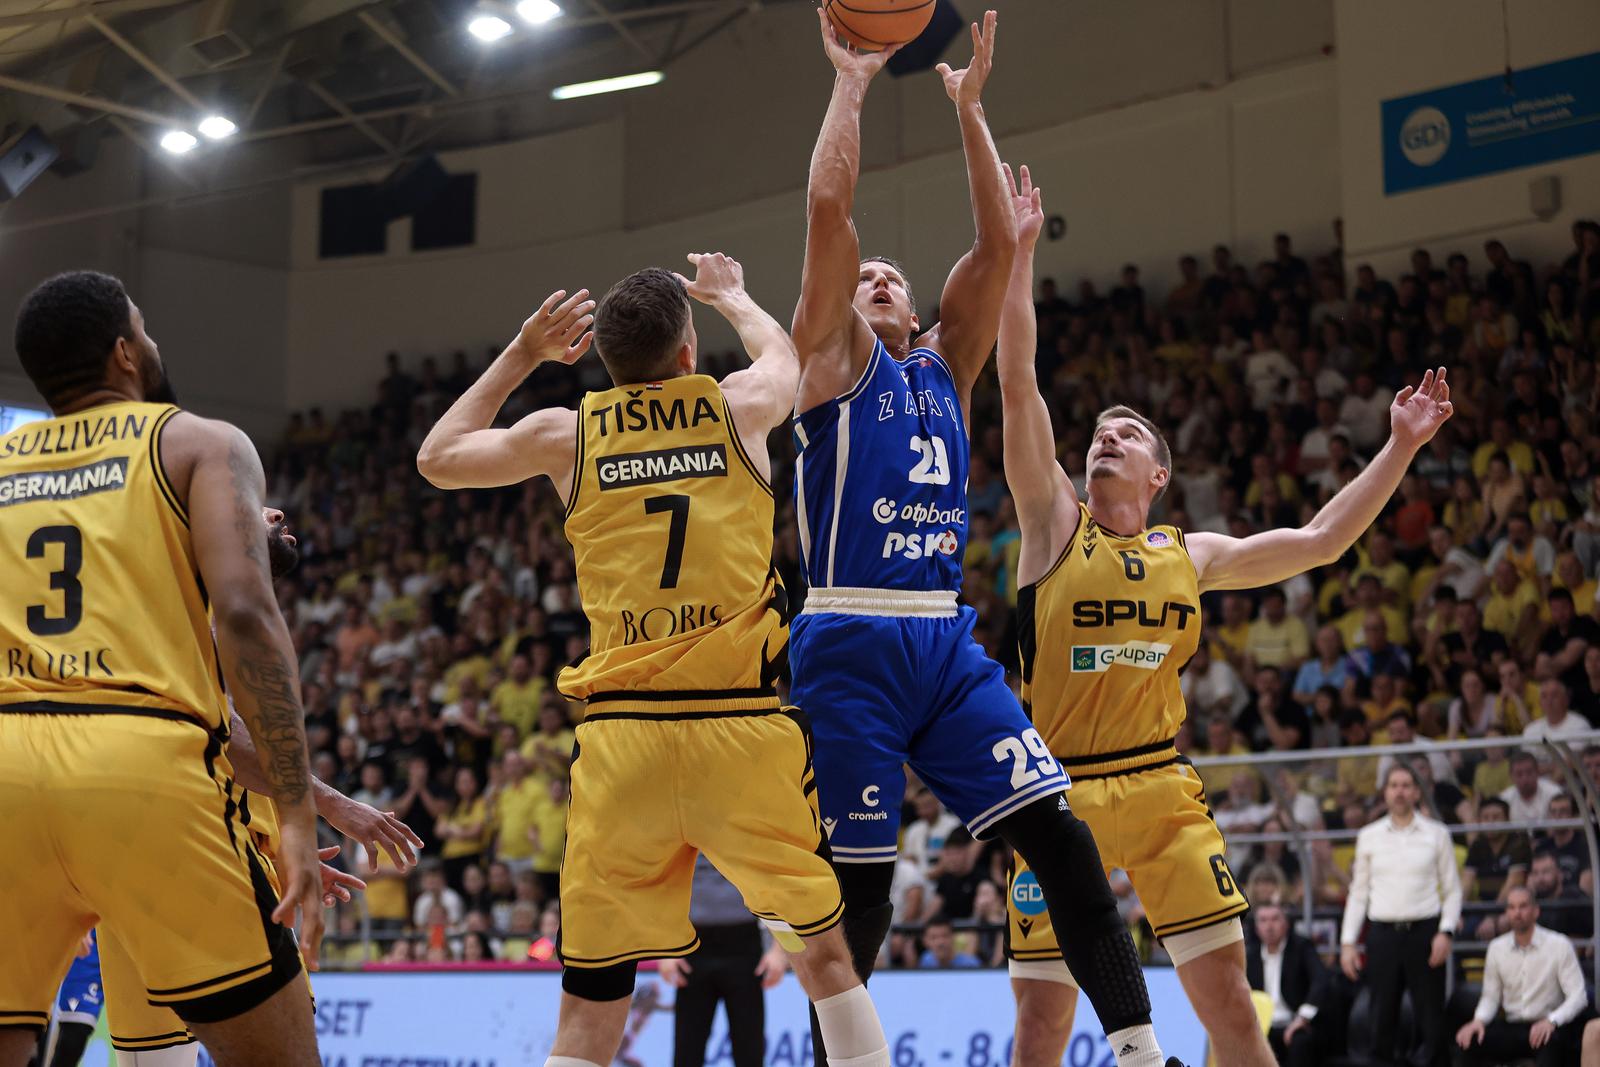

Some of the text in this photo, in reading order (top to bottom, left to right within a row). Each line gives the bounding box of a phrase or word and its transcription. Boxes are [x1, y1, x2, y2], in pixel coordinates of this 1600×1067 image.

[591, 390, 720, 437] TIŠMA
[0, 413, 147, 459] SULLIVAN
[0, 462, 124, 502] GERMANIA
[600, 450, 726, 483] GERMANIA
[644, 494, 690, 590] 7
[26, 525, 83, 636] 3
[1118, 550, 1146, 582] 6
[1072, 600, 1196, 631] SPLIT
[992, 727, 1059, 791] 29
[848, 810, 888, 821] cromaris
[1209, 854, 1234, 897] 6
